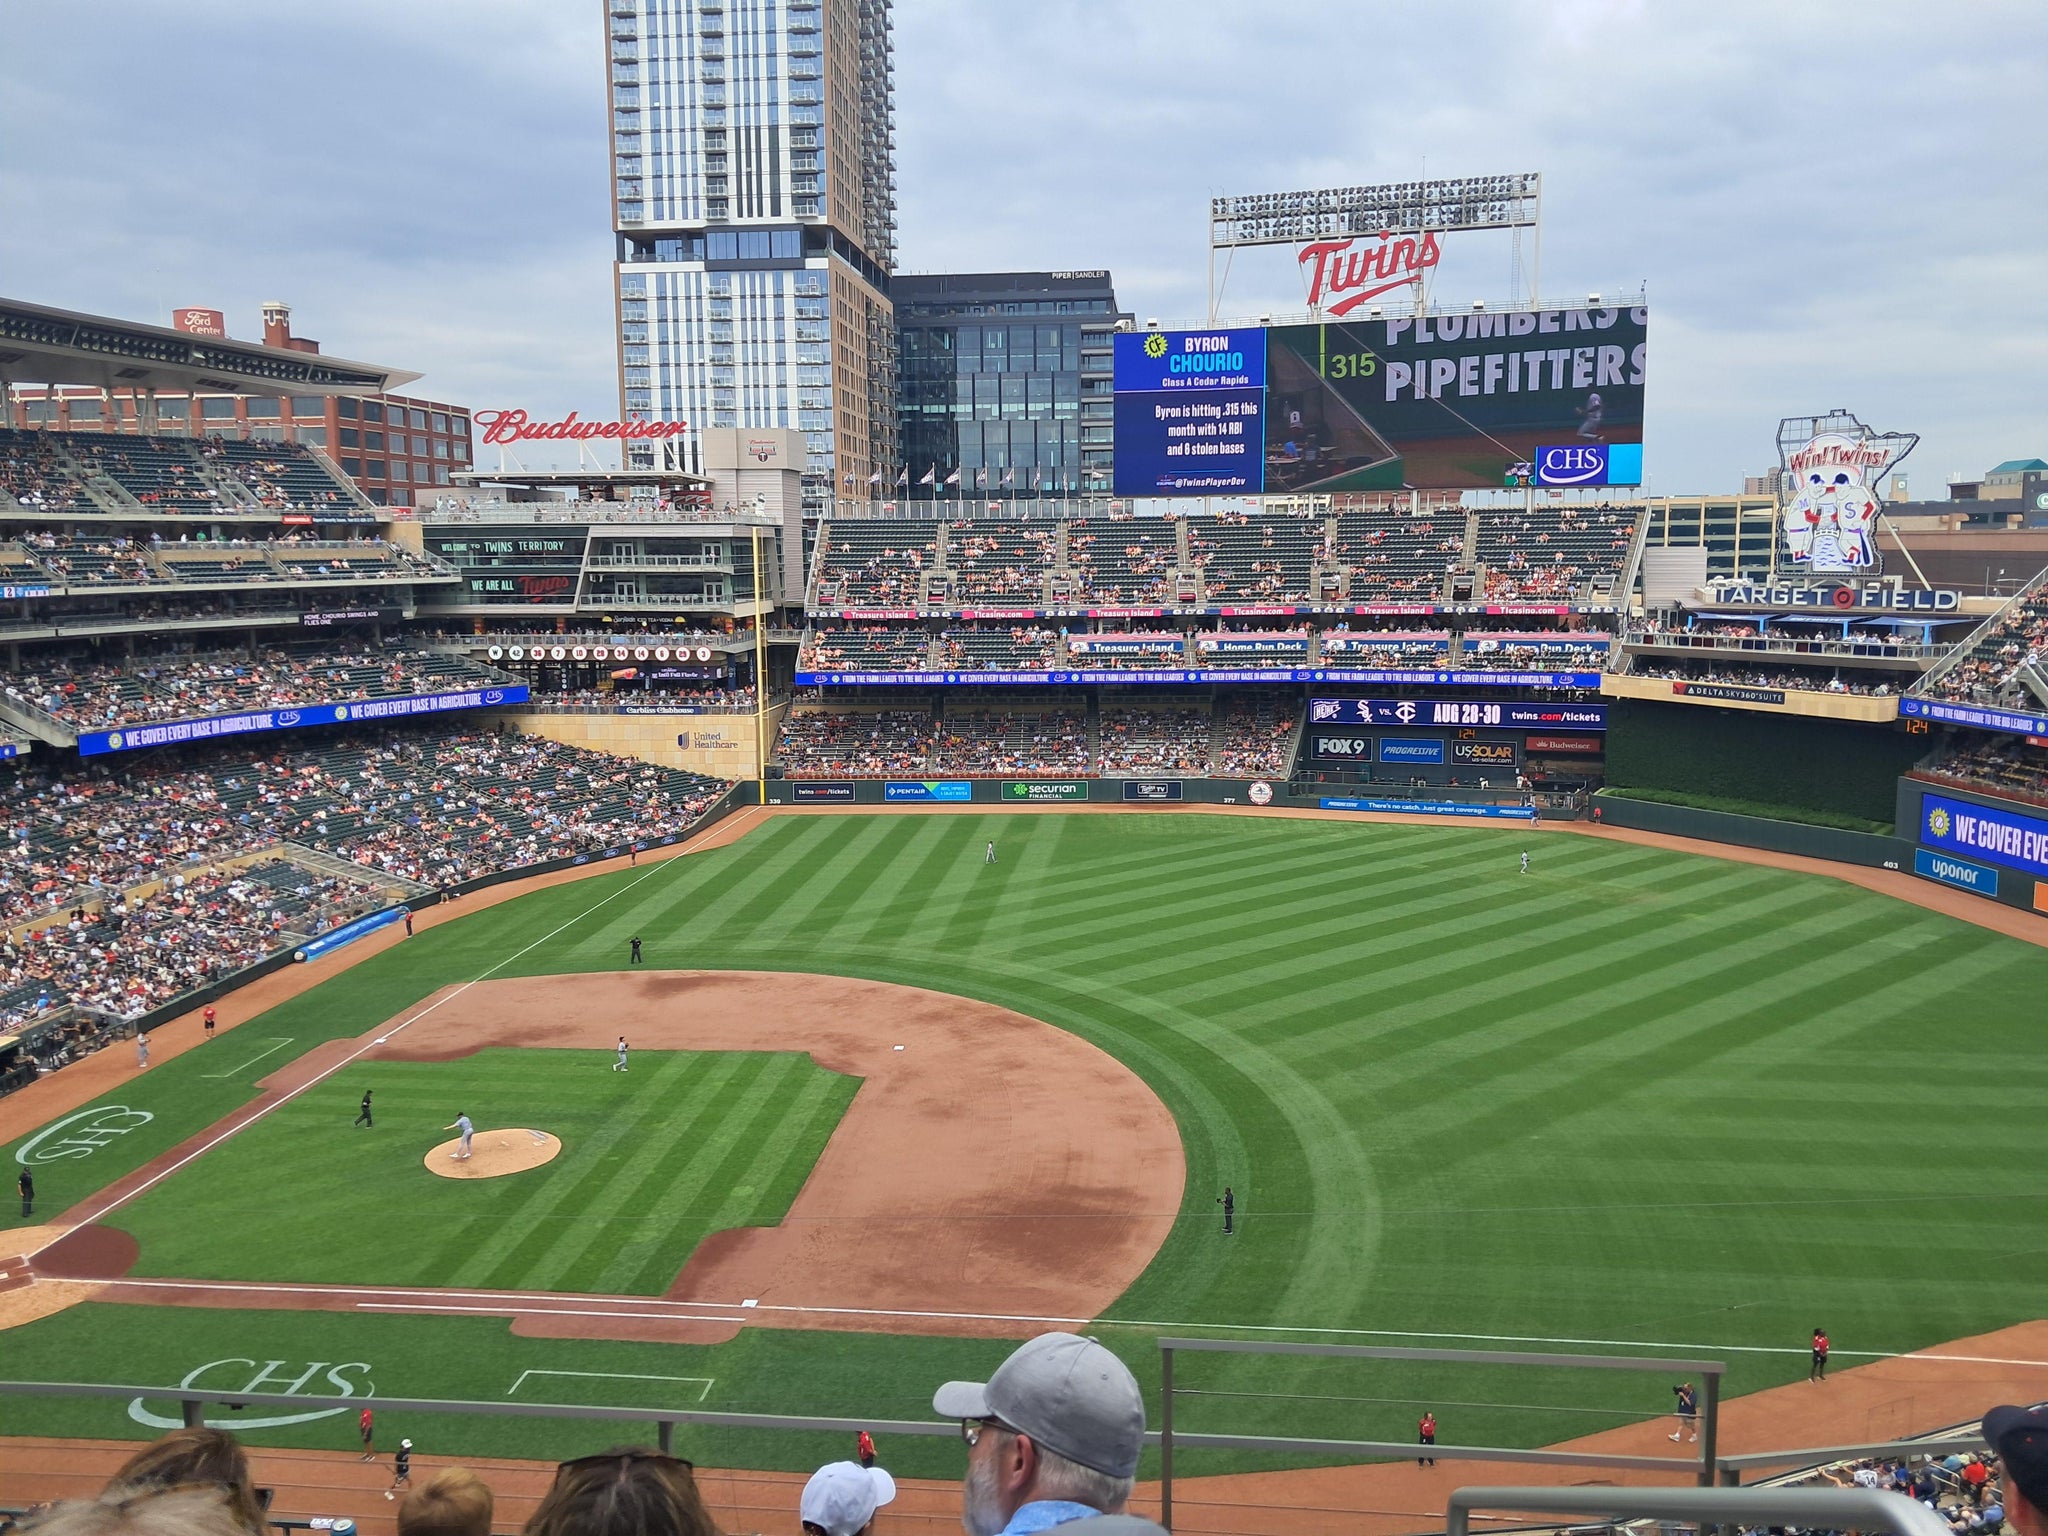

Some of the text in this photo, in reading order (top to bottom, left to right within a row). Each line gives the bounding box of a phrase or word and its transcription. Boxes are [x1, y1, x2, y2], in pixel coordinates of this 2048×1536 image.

[1074, 271, 1105, 279] SANDLER
[1298, 230, 1440, 306] Twins
[184, 311, 211, 326] Ford
[189, 325, 221, 336] Center
[1386, 307, 1618, 346] PLUMBERS
[1148, 337, 1162, 354] CF
[1185, 336, 1228, 352] BYRON
[1169, 352, 1243, 373] CHOURIO
[1330, 353, 1376, 378] 315
[1162, 375, 1249, 387] Class A Cedar Rapids
[1155, 402, 1258, 420] Byron is hitting .315 this
[473, 408, 687, 445] Budweiser
[1168, 421, 1243, 437] month with 14 RBI
[1167, 443, 1183, 456] and
[1191, 441, 1218, 455] stolen
[1220, 441, 1245, 454] bases
[1789, 440, 1890, 472] Win! Twins!
[1546, 448, 1598, 470] CHS
[1175, 477, 1246, 488] @TwinsPlayerDev
[1800, 498, 1809, 508] M
[1844, 502, 1856, 519] S
[441, 543, 467, 552] WELCOME
[484, 541, 513, 552] TWINS
[518, 541, 564, 551] TERRITORY
[471, 576, 570, 599] WE ARE ALL Twins
[1716, 587, 1958, 611] TARGET FIELD
[851, 611, 908, 619] Treasure Island
[1131, 609, 1154, 617] Island
[1363, 607, 1426, 615] Treasure Island
[1094, 643, 1174, 653] Treasure Island
[1223, 642, 1303, 651] Home Run Deck
[1565, 643, 1593, 652] Deck
[1696, 687, 1724, 697] DELTA
[1758, 693, 1782, 702] SUITE
[350, 693, 482, 718] WE COVER EVERY BASE IN AGRICULTURE
[657, 706, 694, 714] Clubhouse
[1379, 704, 1600, 724] vs. AUG 28-30 twins.com/tickets
[126, 714, 273, 747] WE COVER EVERY BASE IN AGRICULTURE
[694, 732, 720, 740] United
[1318, 738, 1364, 754] FOX 9
[1383, 746, 1440, 756] PROGRESSIVE
[1029, 785, 1076, 793] securian
[1955, 814, 1976, 845] WE
[1978, 820, 2021, 857] COVER
[1883, 860, 1898, 869] 403
[1932, 858, 1979, 885] uponor
[180, 1358, 375, 1398] CHS
[1866, 1476, 1875, 1485] 14
